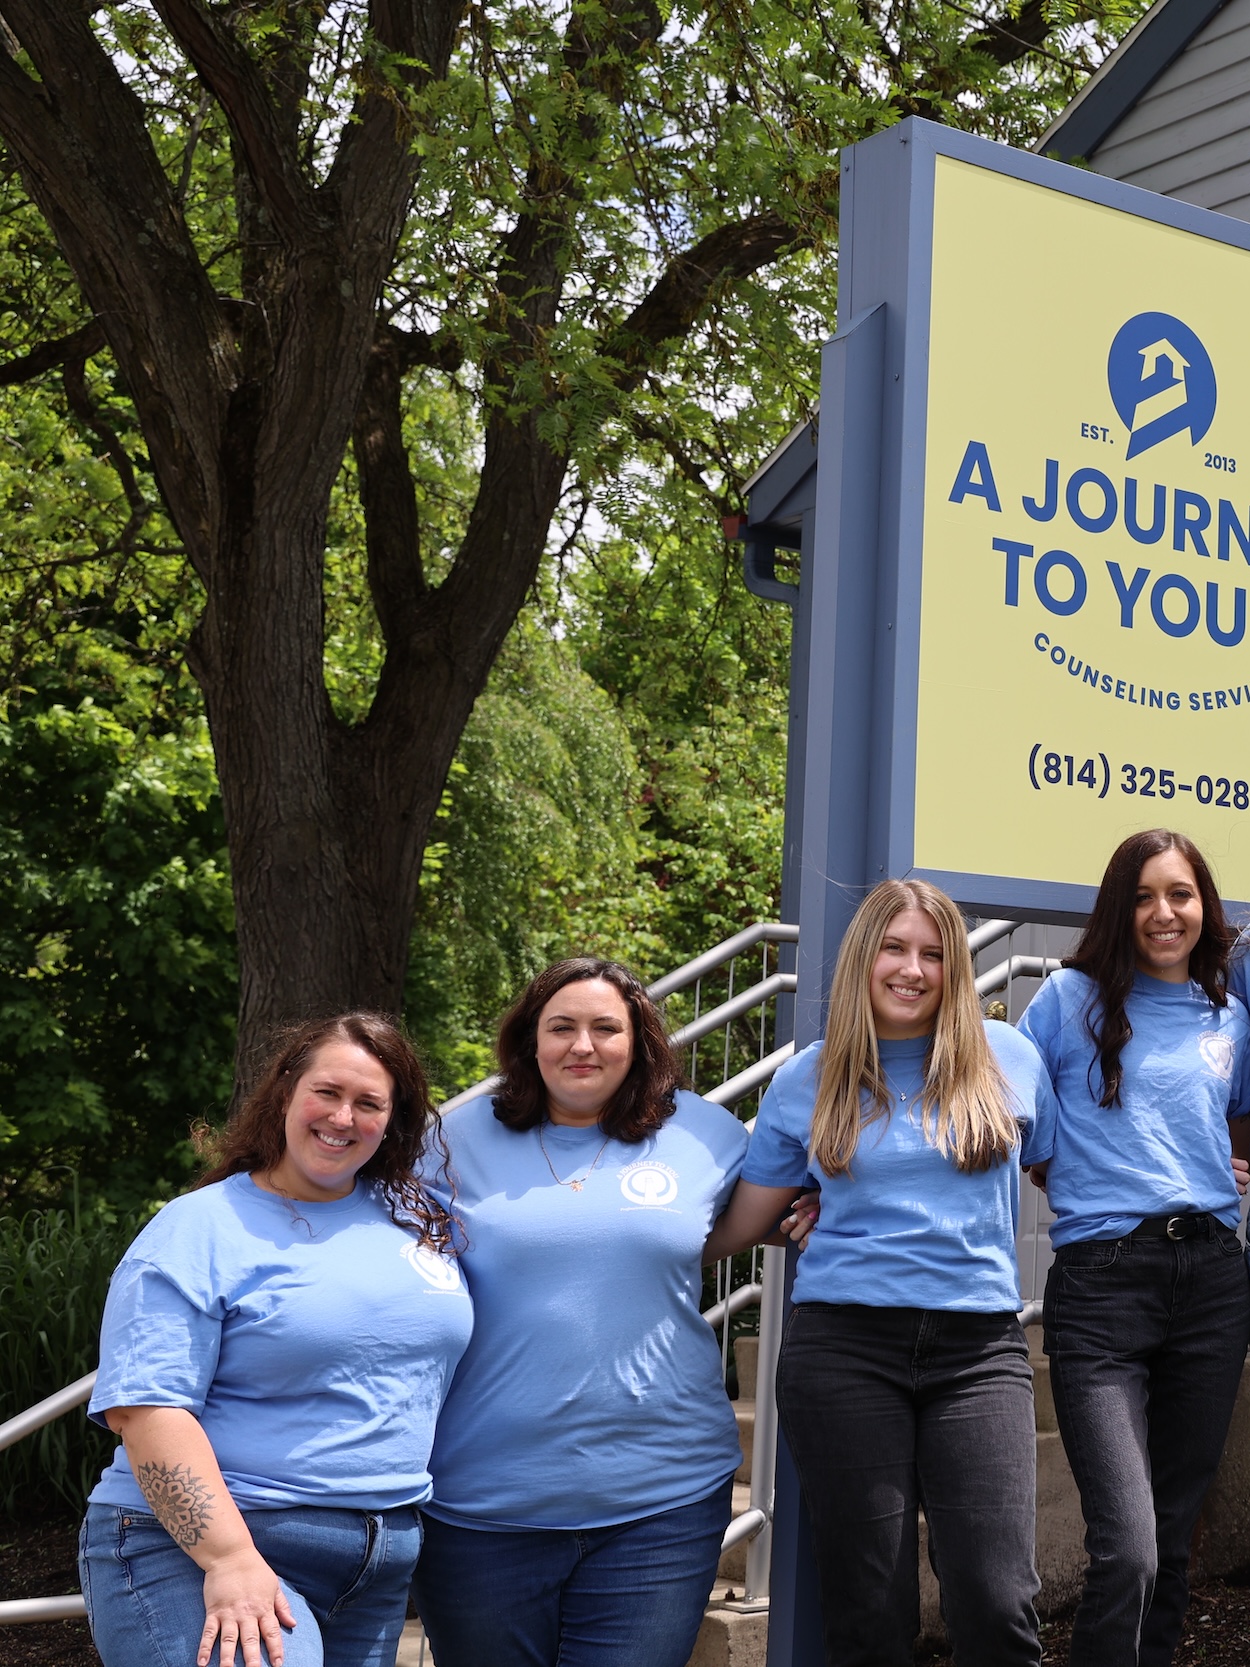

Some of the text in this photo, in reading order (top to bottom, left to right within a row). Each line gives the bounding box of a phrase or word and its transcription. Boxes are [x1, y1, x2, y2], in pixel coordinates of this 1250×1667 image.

[1081, 423, 1114, 445] EST.
[948, 441, 1002, 513] A
[1204, 453, 1237, 474] 2013
[992, 537, 1087, 617] TO
[1105, 561, 1247, 648] YOU
[1034, 632, 1181, 711] COUNSELING
[1028, 743, 1111, 799] (814)
[620, 1160, 653, 1176] JOURNEY
[654, 1161, 666, 1169] TO
[665, 1166, 680, 1179] YOU
